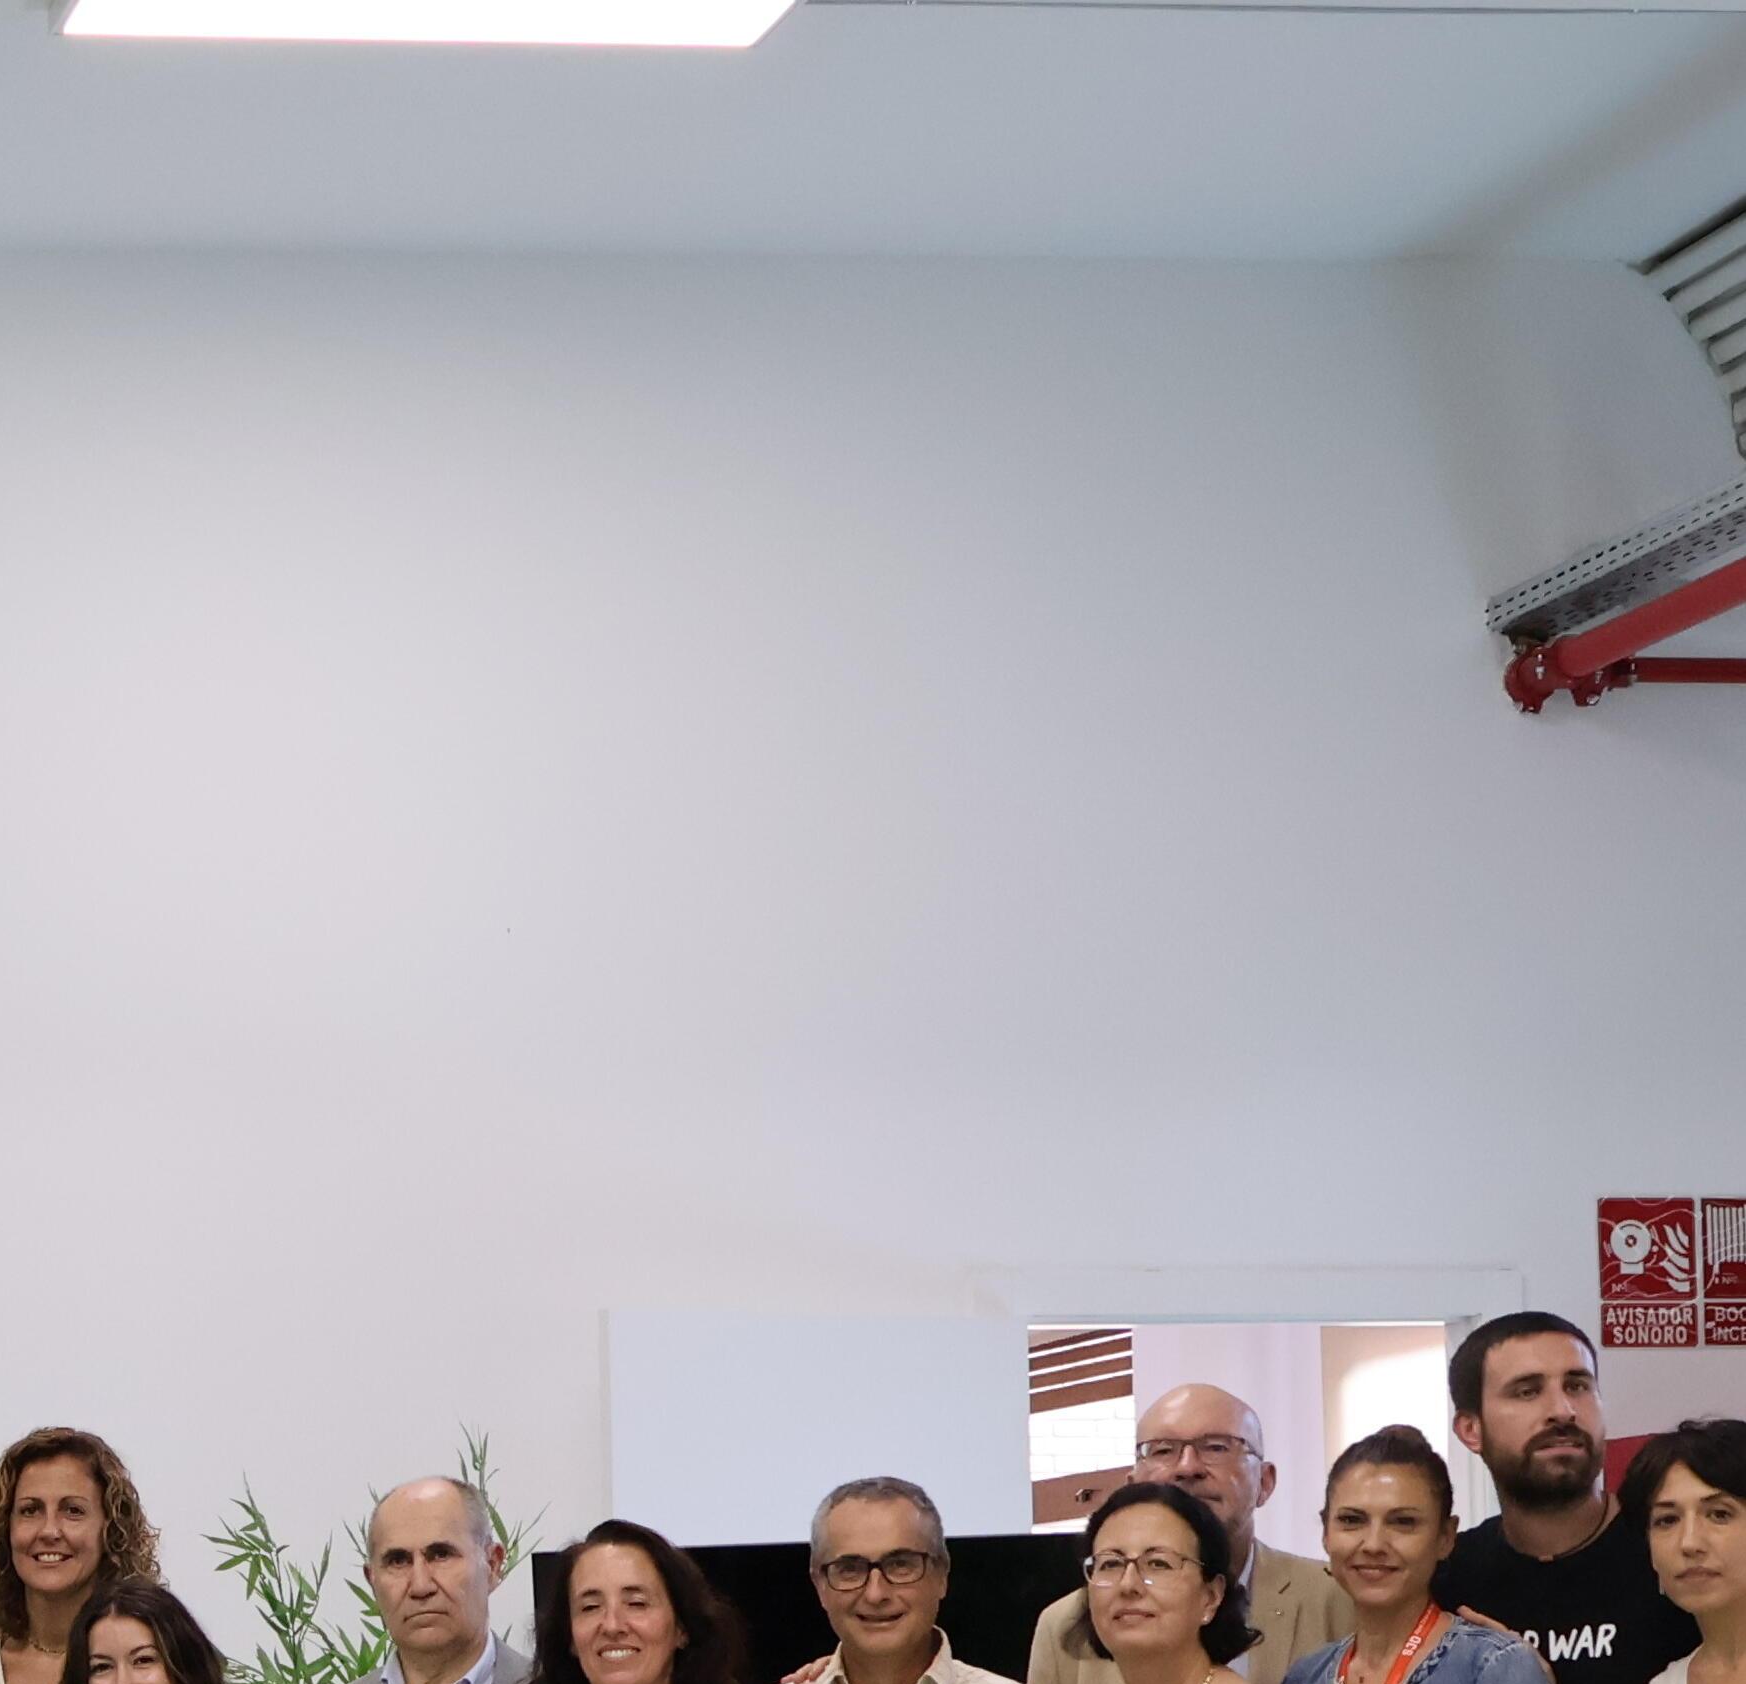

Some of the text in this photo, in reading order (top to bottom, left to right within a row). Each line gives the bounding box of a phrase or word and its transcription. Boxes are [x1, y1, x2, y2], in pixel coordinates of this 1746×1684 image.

[1606, 1306, 1694, 1326] AVISADOR
[1612, 1326, 1688, 1344] SONORO
[1548, 1623, 1617, 1662] WAR
